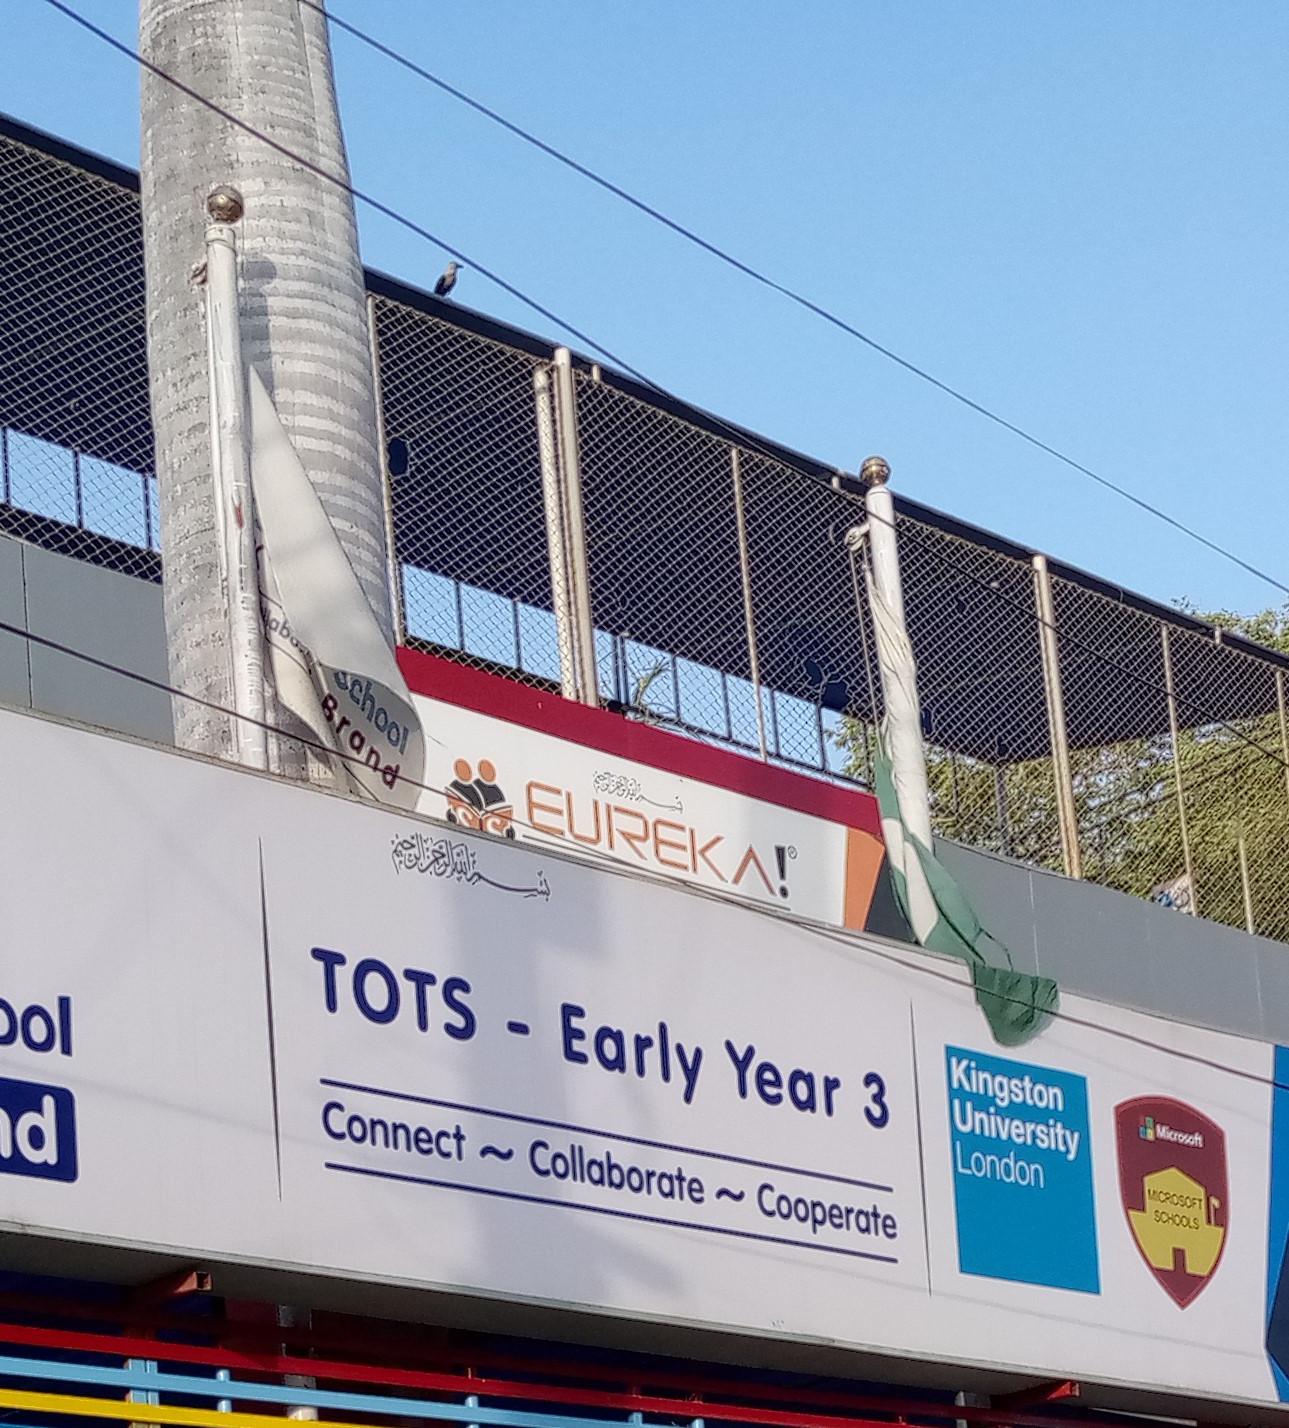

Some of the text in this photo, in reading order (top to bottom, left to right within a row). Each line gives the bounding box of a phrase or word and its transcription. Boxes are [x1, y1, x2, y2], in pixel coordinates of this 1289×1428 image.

[322, 693, 400, 789] Brand
[311, 948, 477, 1040] TOTS
[560, 1003, 702, 1104] Early
[725, 1040, 841, 1116] Year
[862, 1072, 890, 1129] 3
[950, 1056, 1064, 1111] Kingston
[952, 1098, 1080, 1161] University
[1156, 1123, 1205, 1148] Microsoft
[322, 1101, 464, 1161] Connect
[529, 1141, 705, 1204] Collaborate
[757, 1183, 898, 1239] Cooperate
[956, 1142, 1044, 1188] London
[1148, 1189, 1203, 1210] MICROSOFT
[1154, 1210, 1200, 1230] SCHOOLS
